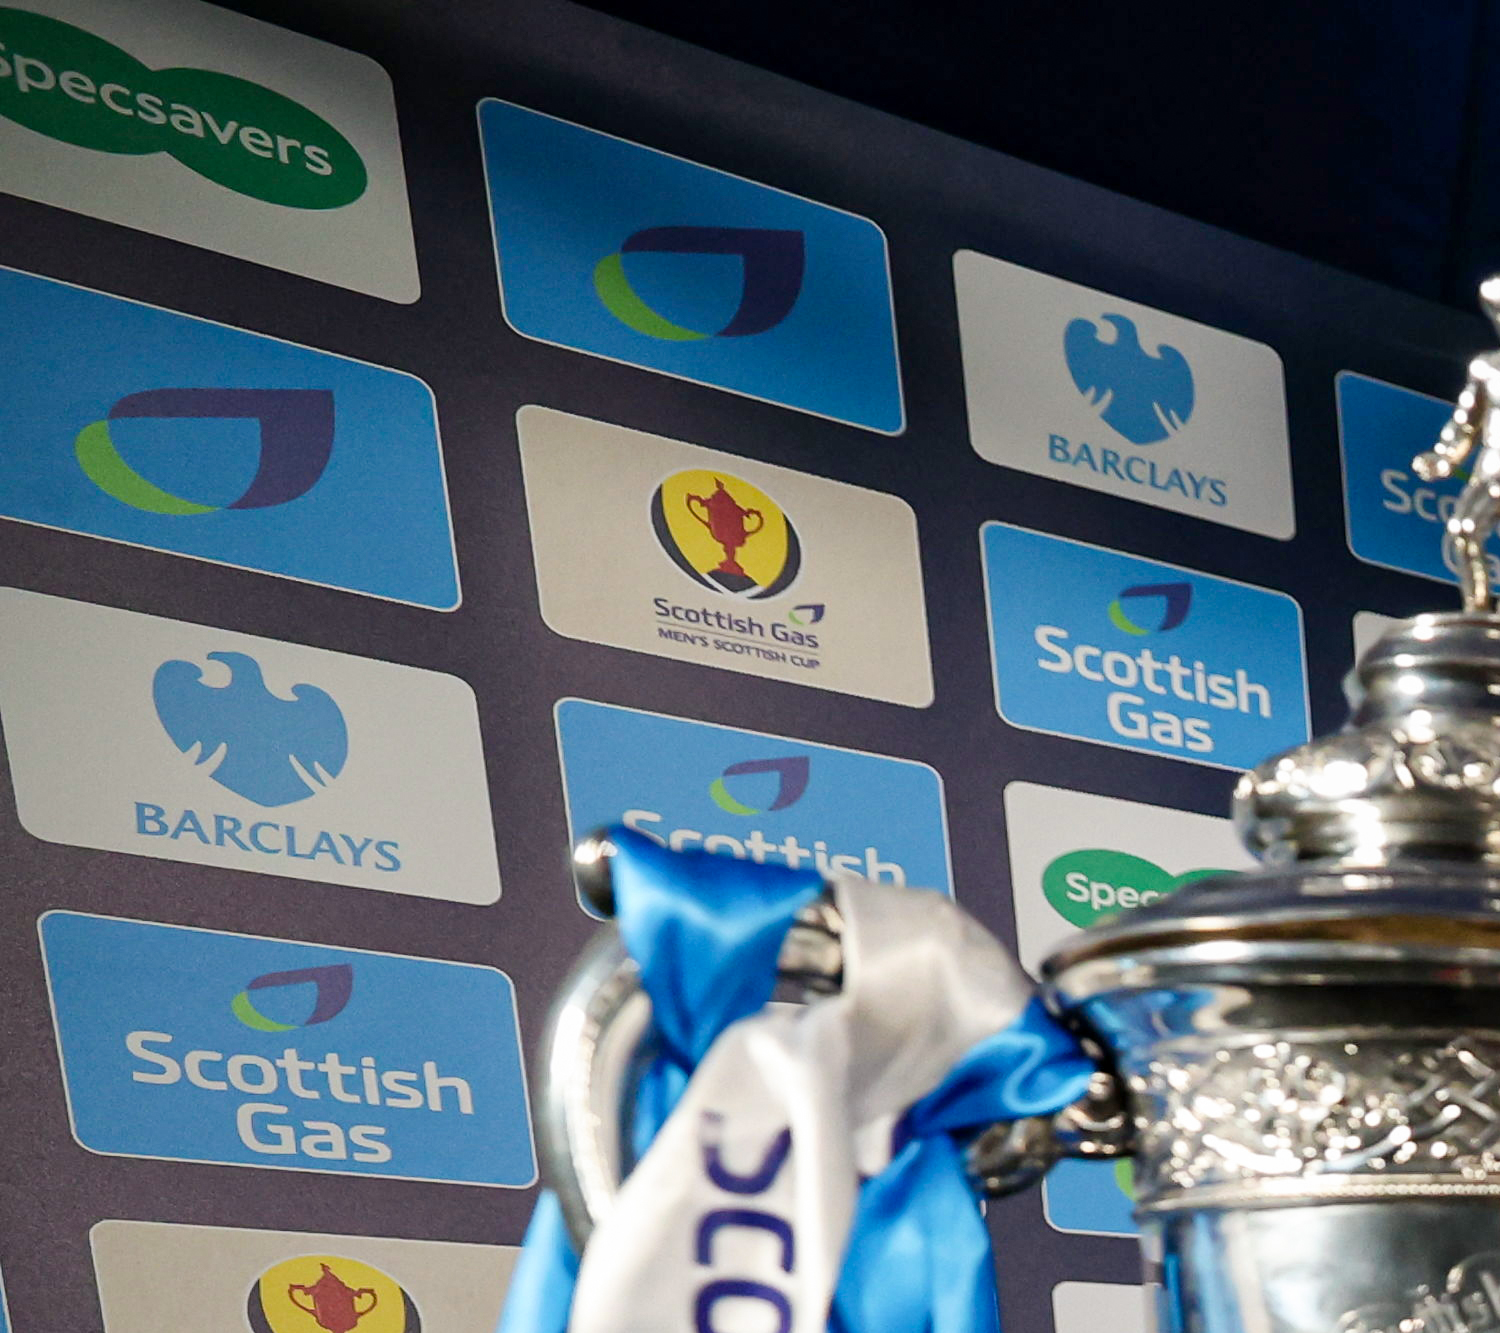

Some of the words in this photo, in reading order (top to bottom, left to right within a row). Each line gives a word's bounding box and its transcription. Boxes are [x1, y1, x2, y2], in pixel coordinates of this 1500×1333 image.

[0, 42, 332, 177] pecsavers
[1048, 433, 1228, 507] BARCLAYS
[653, 597, 765, 640] Scottish
[771, 617, 820, 650] Gas
[657, 628, 711, 650] MEN'S
[713, 636, 787, 663] SCOTTISH
[789, 652, 821, 670] CUP
[1034, 625, 1272, 718] Scottish
[1106, 691, 1214, 753] Gas
[134, 802, 402, 873] BARCLAYS
[126, 1030, 474, 1115] Scottish
[236, 1103, 392, 1164] Gas
